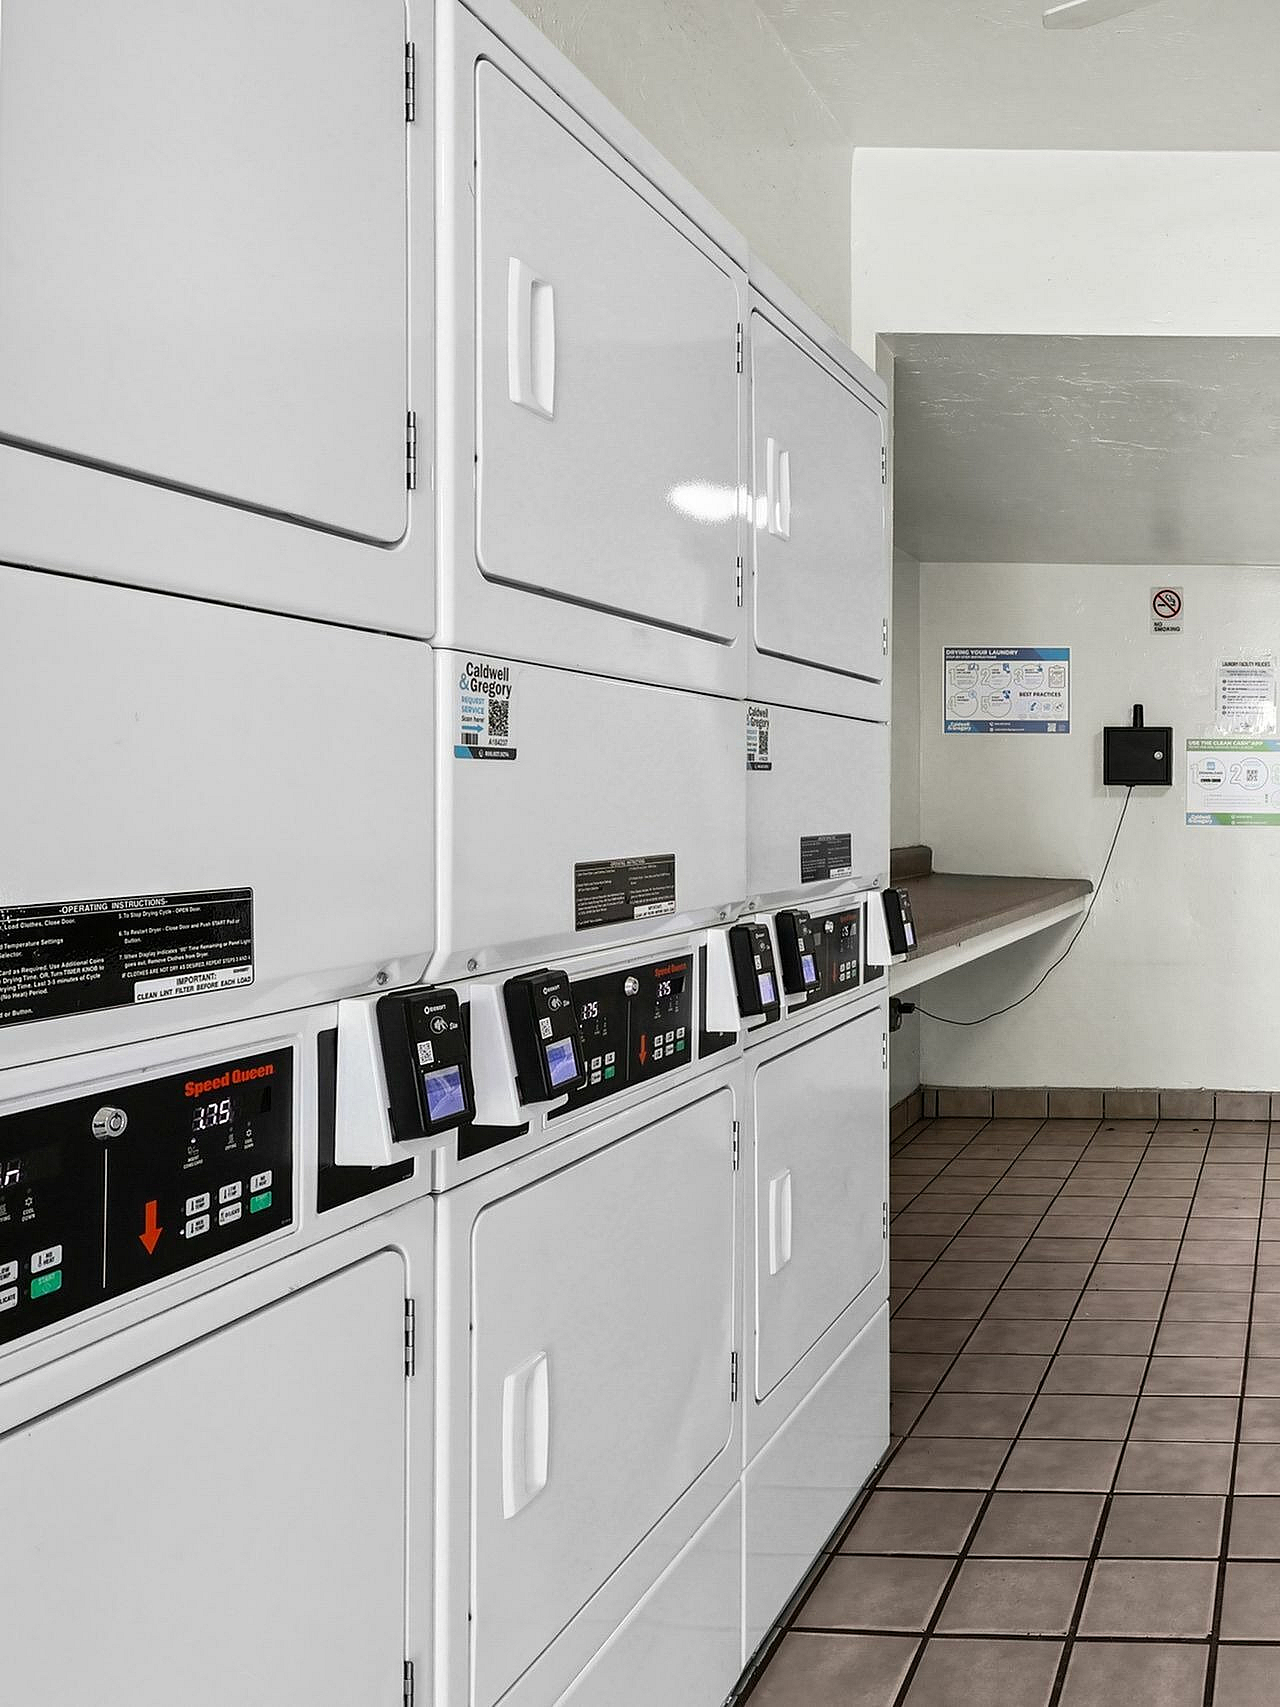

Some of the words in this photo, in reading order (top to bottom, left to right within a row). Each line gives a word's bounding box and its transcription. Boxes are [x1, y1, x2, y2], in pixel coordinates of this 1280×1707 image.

[466, 662, 509, 682] Caldwell
[459, 672, 469, 690] &
[470, 678, 512, 699] Gregory
[4, 940, 39, 949] Temperature
[61, 960, 88, 968] Additional
[176, 973, 217, 985] IMPORTANT:
[137, 992, 157, 1000] CLEAN
[160, 989, 173, 997] LINT
[175, 986, 194, 994] FILTER
[196, 982, 218, 991] BEFORE
[184, 1072, 230, 1098] Speed
[232, 1063, 274, 1084] Queen
